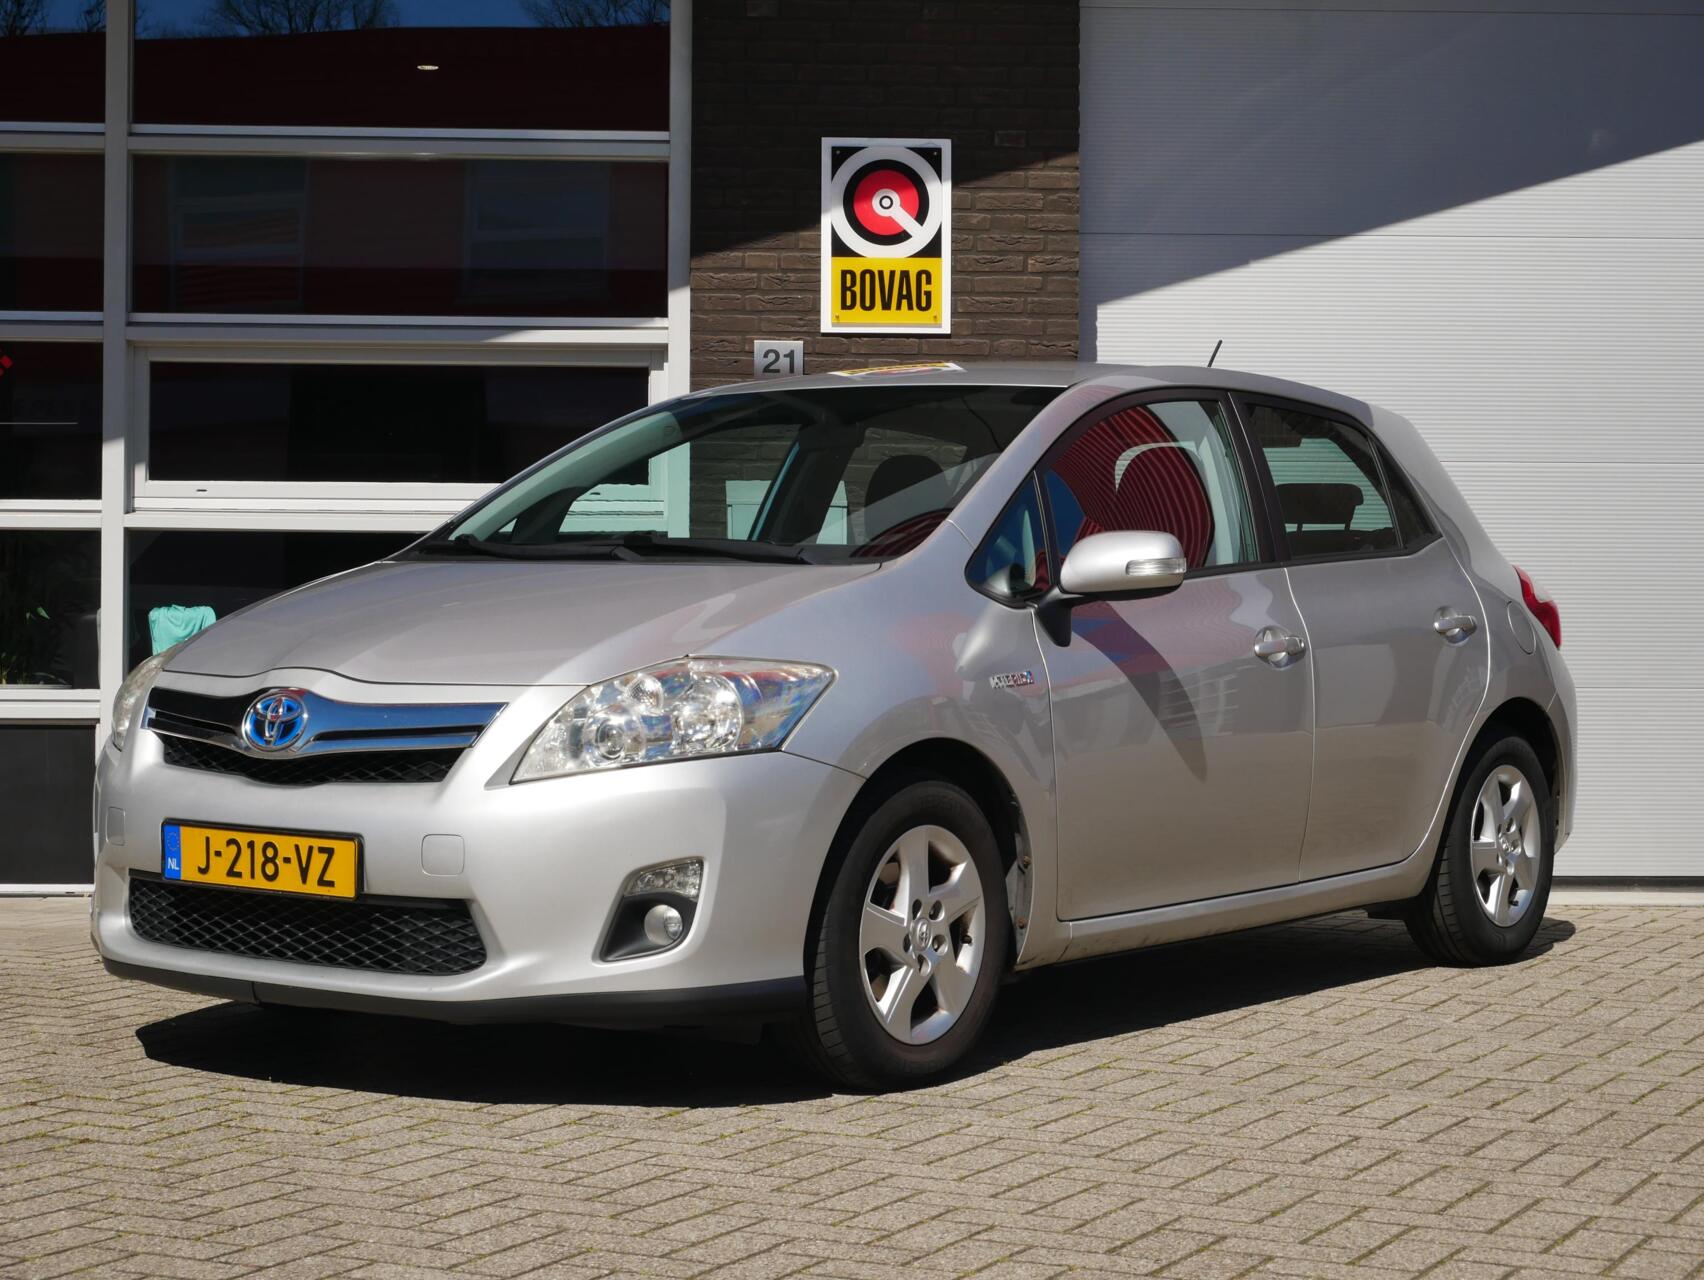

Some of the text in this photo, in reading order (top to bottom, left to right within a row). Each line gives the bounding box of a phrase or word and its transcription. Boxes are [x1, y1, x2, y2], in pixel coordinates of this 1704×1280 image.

[841, 270, 932, 312] BOVAG
[762, 349, 796, 374] 21
[168, 857, 181, 871] NL
[198, 836, 336, 888] J-218-VZ
